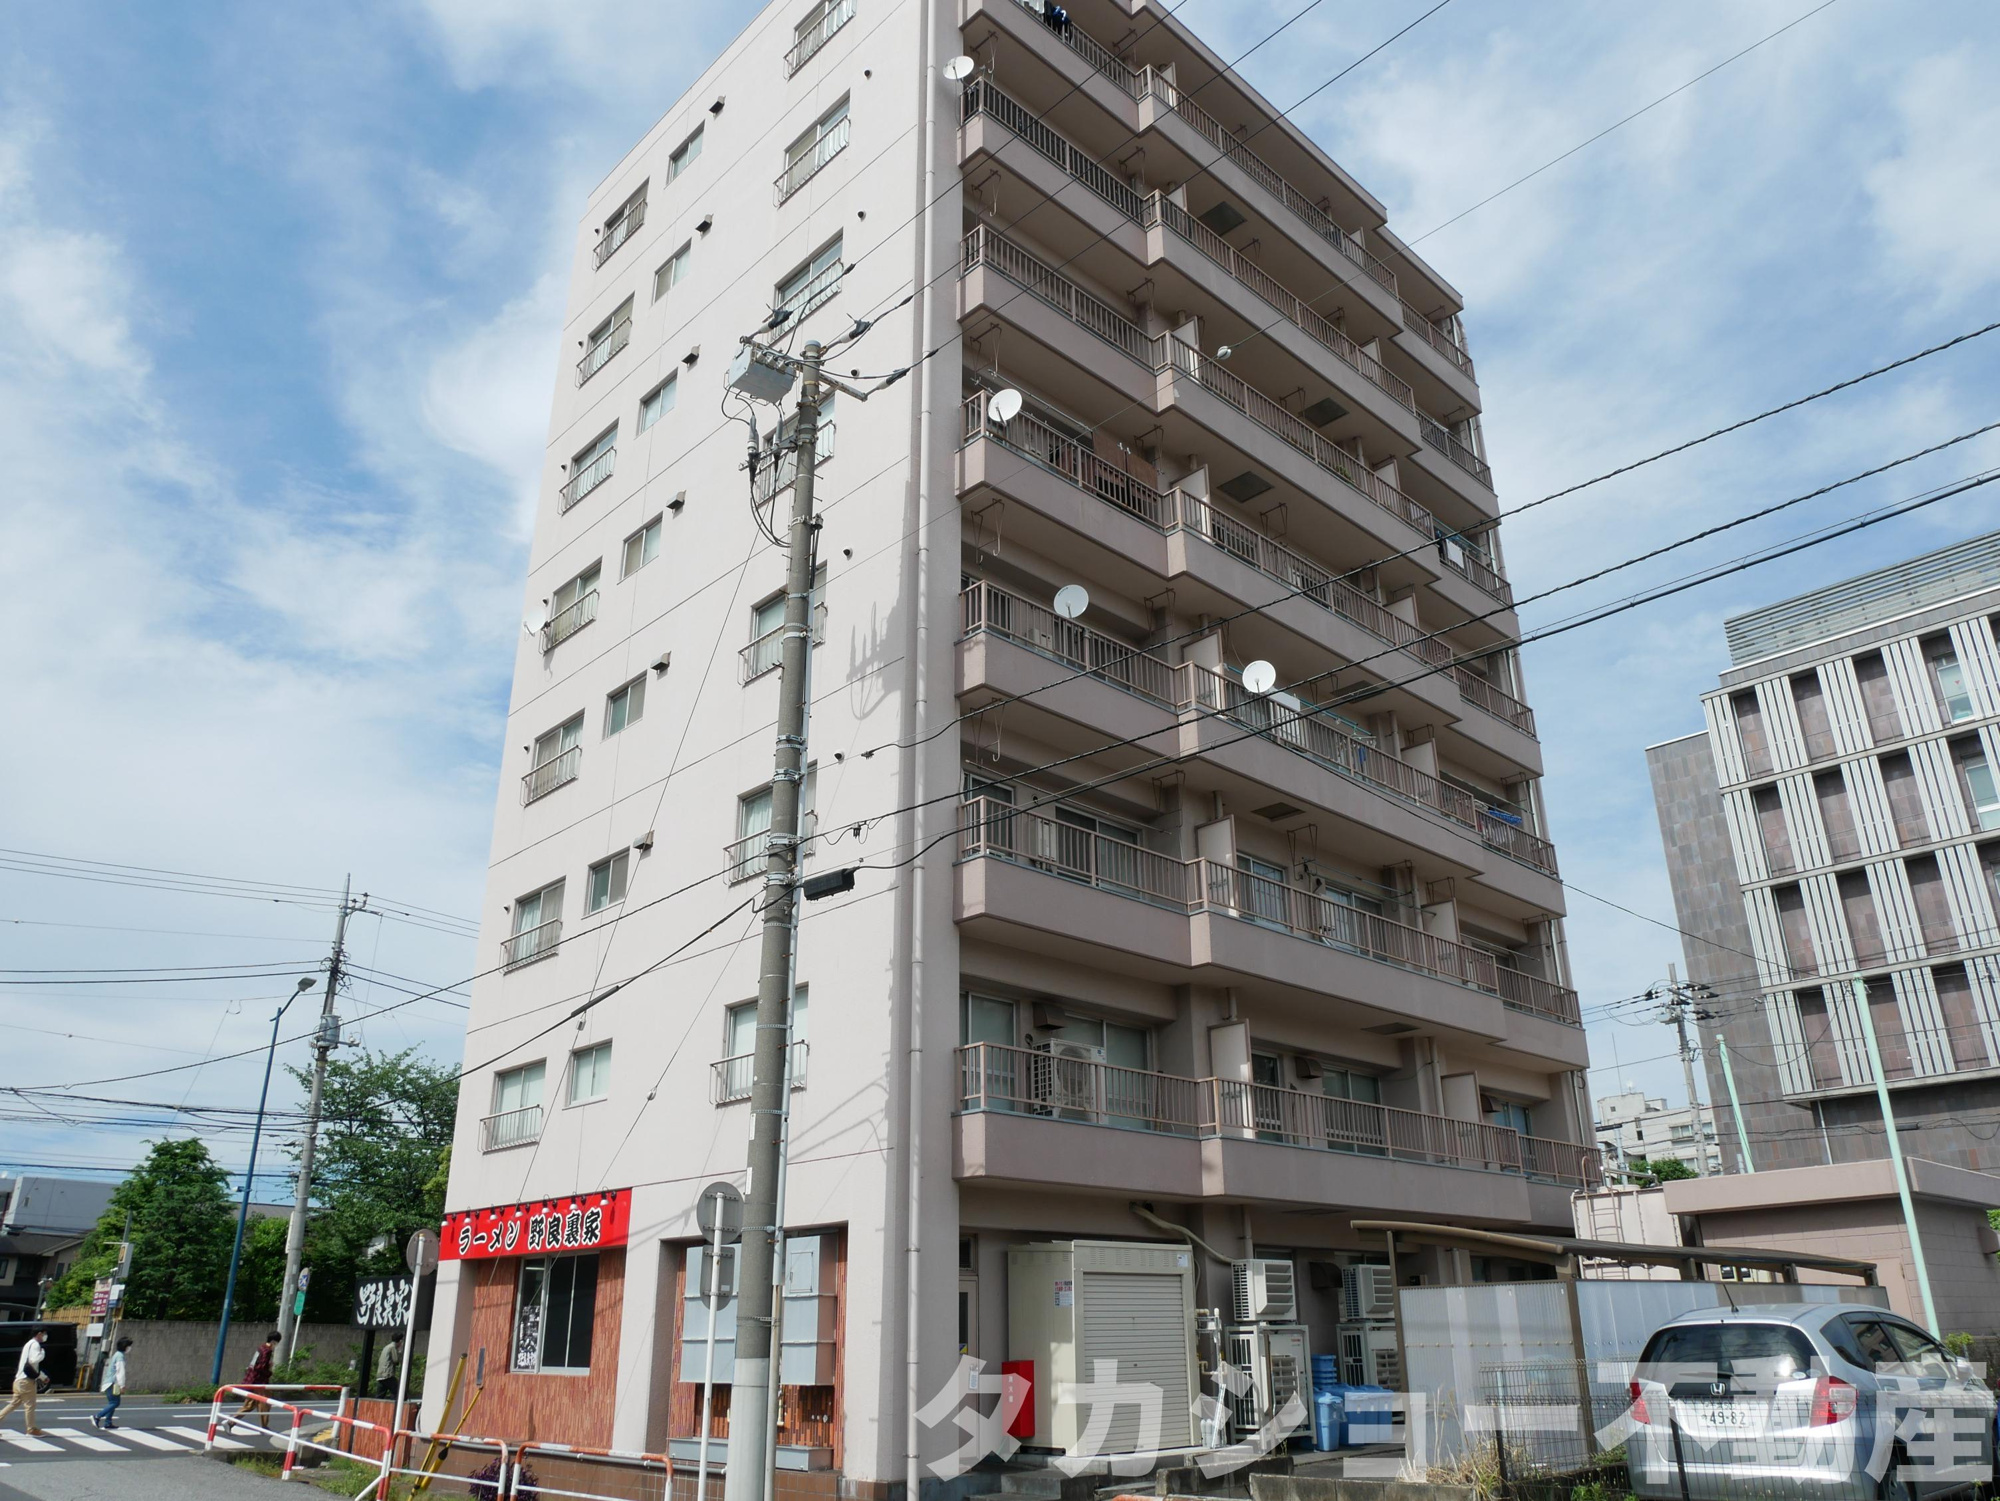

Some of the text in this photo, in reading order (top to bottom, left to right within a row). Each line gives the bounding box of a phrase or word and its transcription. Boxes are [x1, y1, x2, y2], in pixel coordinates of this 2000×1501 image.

[458, 1207, 602, 1255] ラーメン 野良裏家
[1710, 1411, 1746, 1425] 49-82
